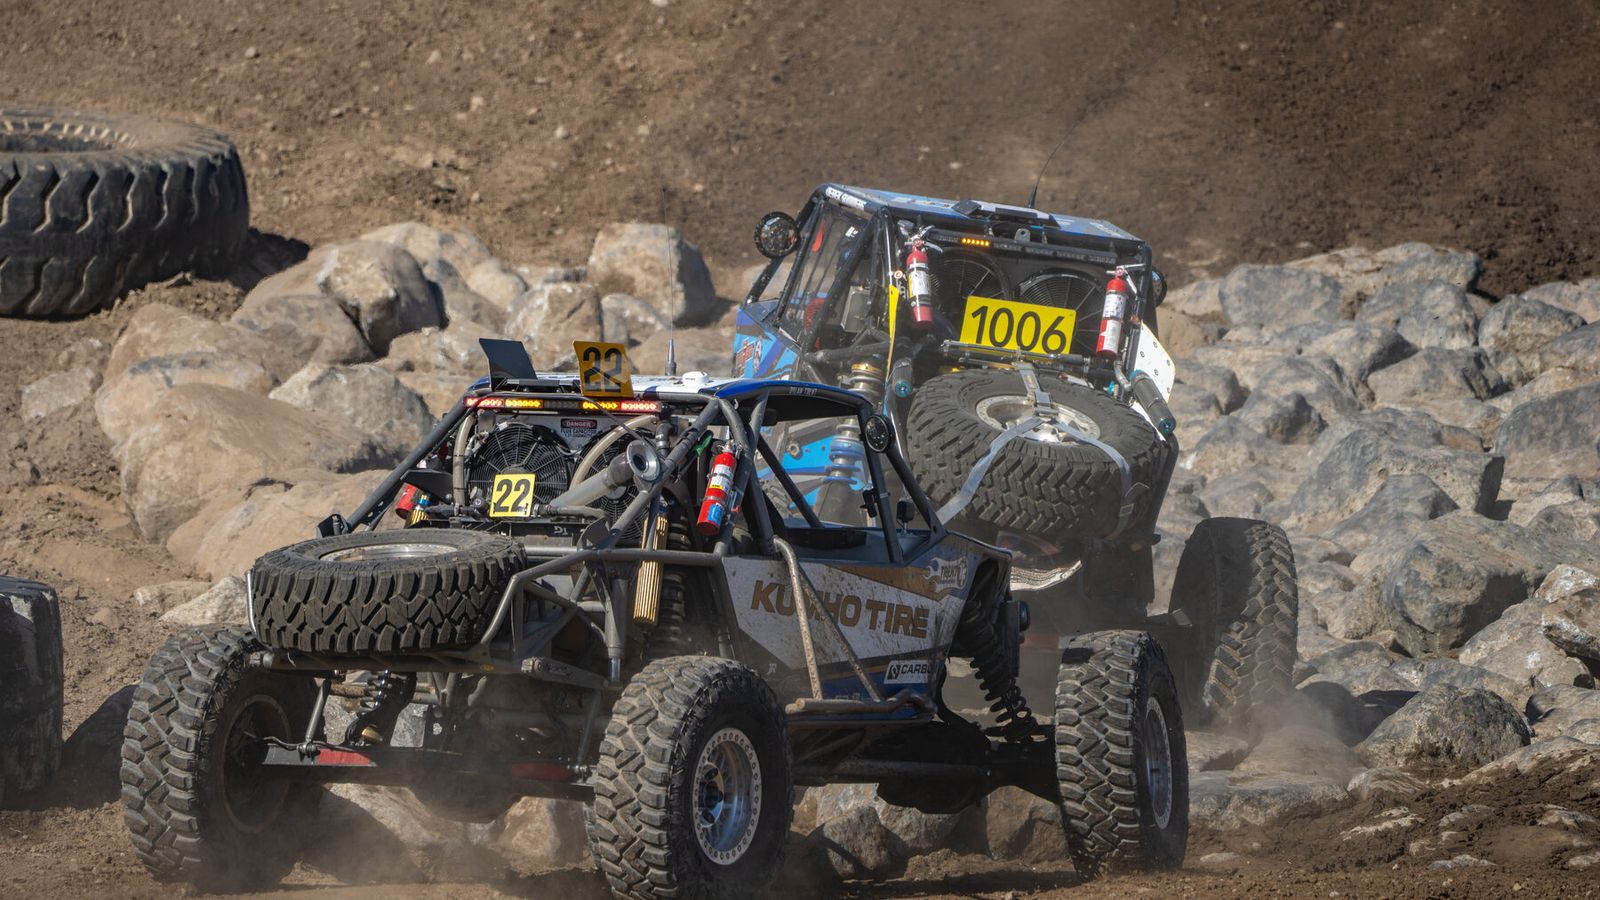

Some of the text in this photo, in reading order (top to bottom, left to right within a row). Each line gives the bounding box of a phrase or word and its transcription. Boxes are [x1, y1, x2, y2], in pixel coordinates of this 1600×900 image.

[967, 305, 1066, 354] 1006
[583, 346, 622, 392] 22
[494, 479, 531, 512] 22
[865, 599, 930, 639] TIRE
